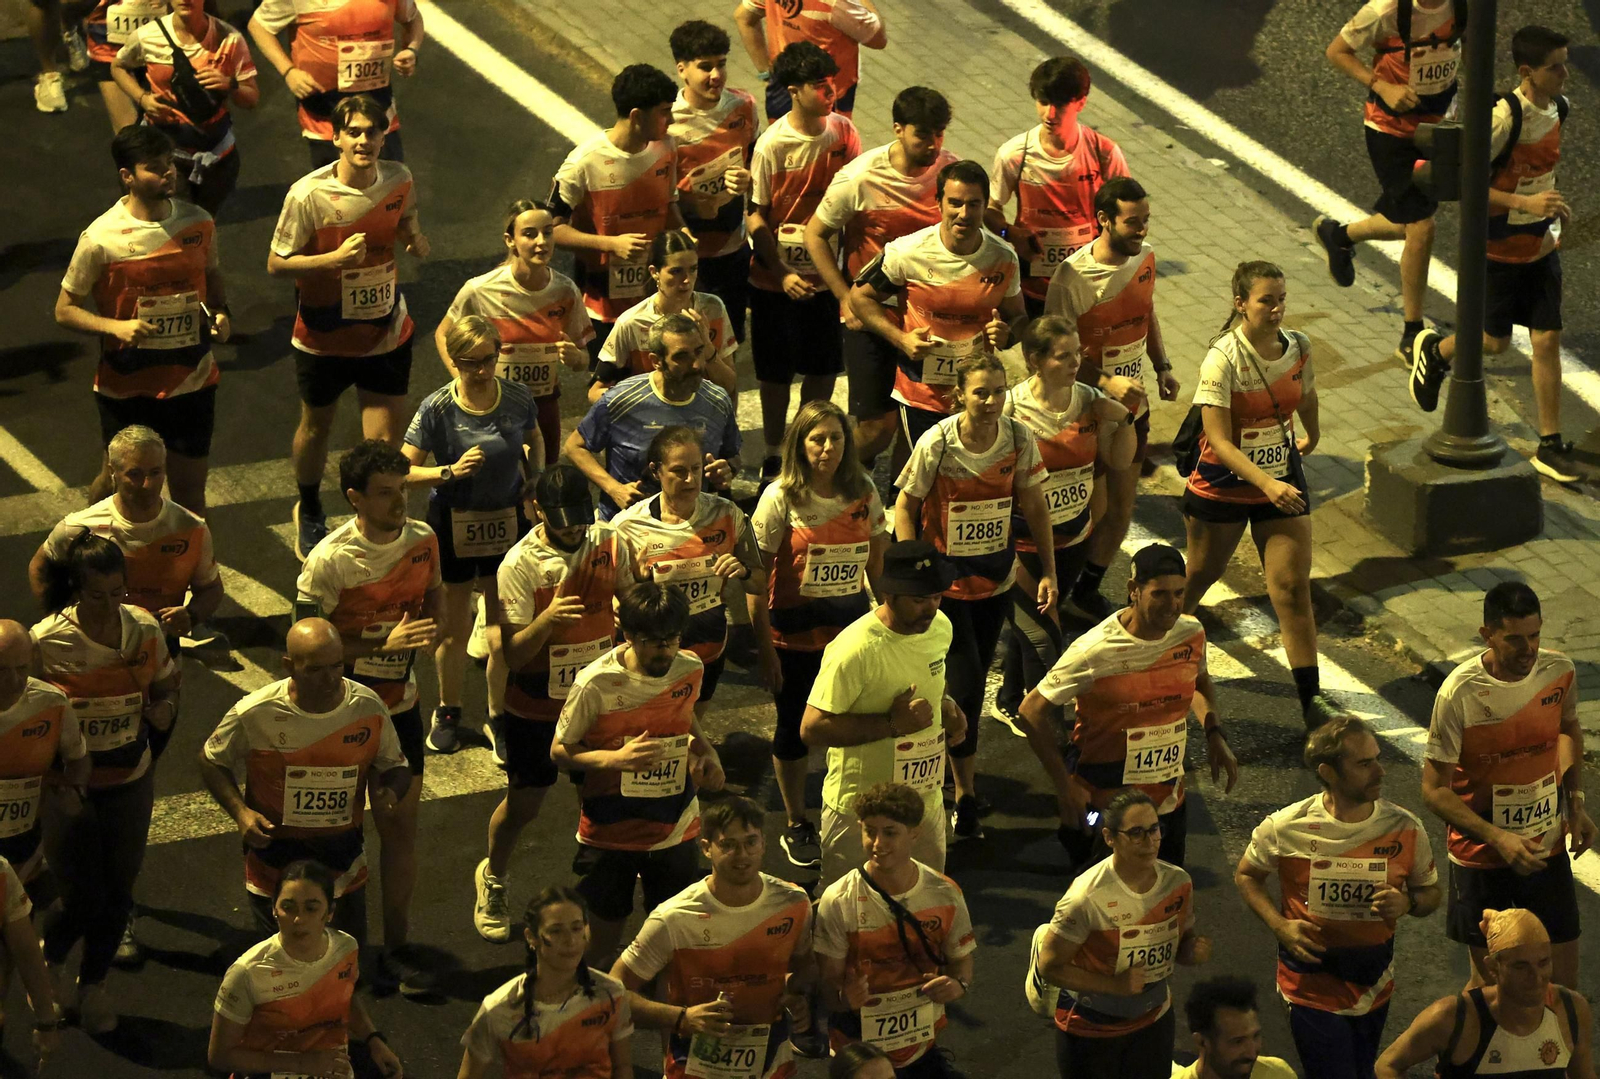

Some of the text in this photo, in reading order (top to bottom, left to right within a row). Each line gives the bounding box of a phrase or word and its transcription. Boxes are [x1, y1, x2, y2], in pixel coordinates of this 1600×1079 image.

[345, 61, 385, 79] 13021
[349, 283, 391, 306] 13818
[502, 364, 550, 383] 13808
[1247, 445, 1289, 467] 12887
[1044, 483, 1088, 510] 12886
[466, 520, 507, 542] 5105
[955, 520, 1004, 541] 12885
[811, 564, 858, 583] 13050
[79, 716, 131, 738] 16784
[343, 731, 367, 746] KH7
[1134, 744, 1180, 769] 14749
[901, 755, 942, 781] 17077
[292, 790, 348, 810] 12558
[1501, 797, 1551, 825] 14744
[1373, 843, 1399, 857] KH7
[1335, 861, 1348, 869] NO
[1317, 881, 1376, 903] 13642
[766, 920, 793, 937] KH7
[1126, 942, 1173, 967] 13638
[272, 981, 300, 993] NO DO
[875, 1009, 919, 1037] 7201
